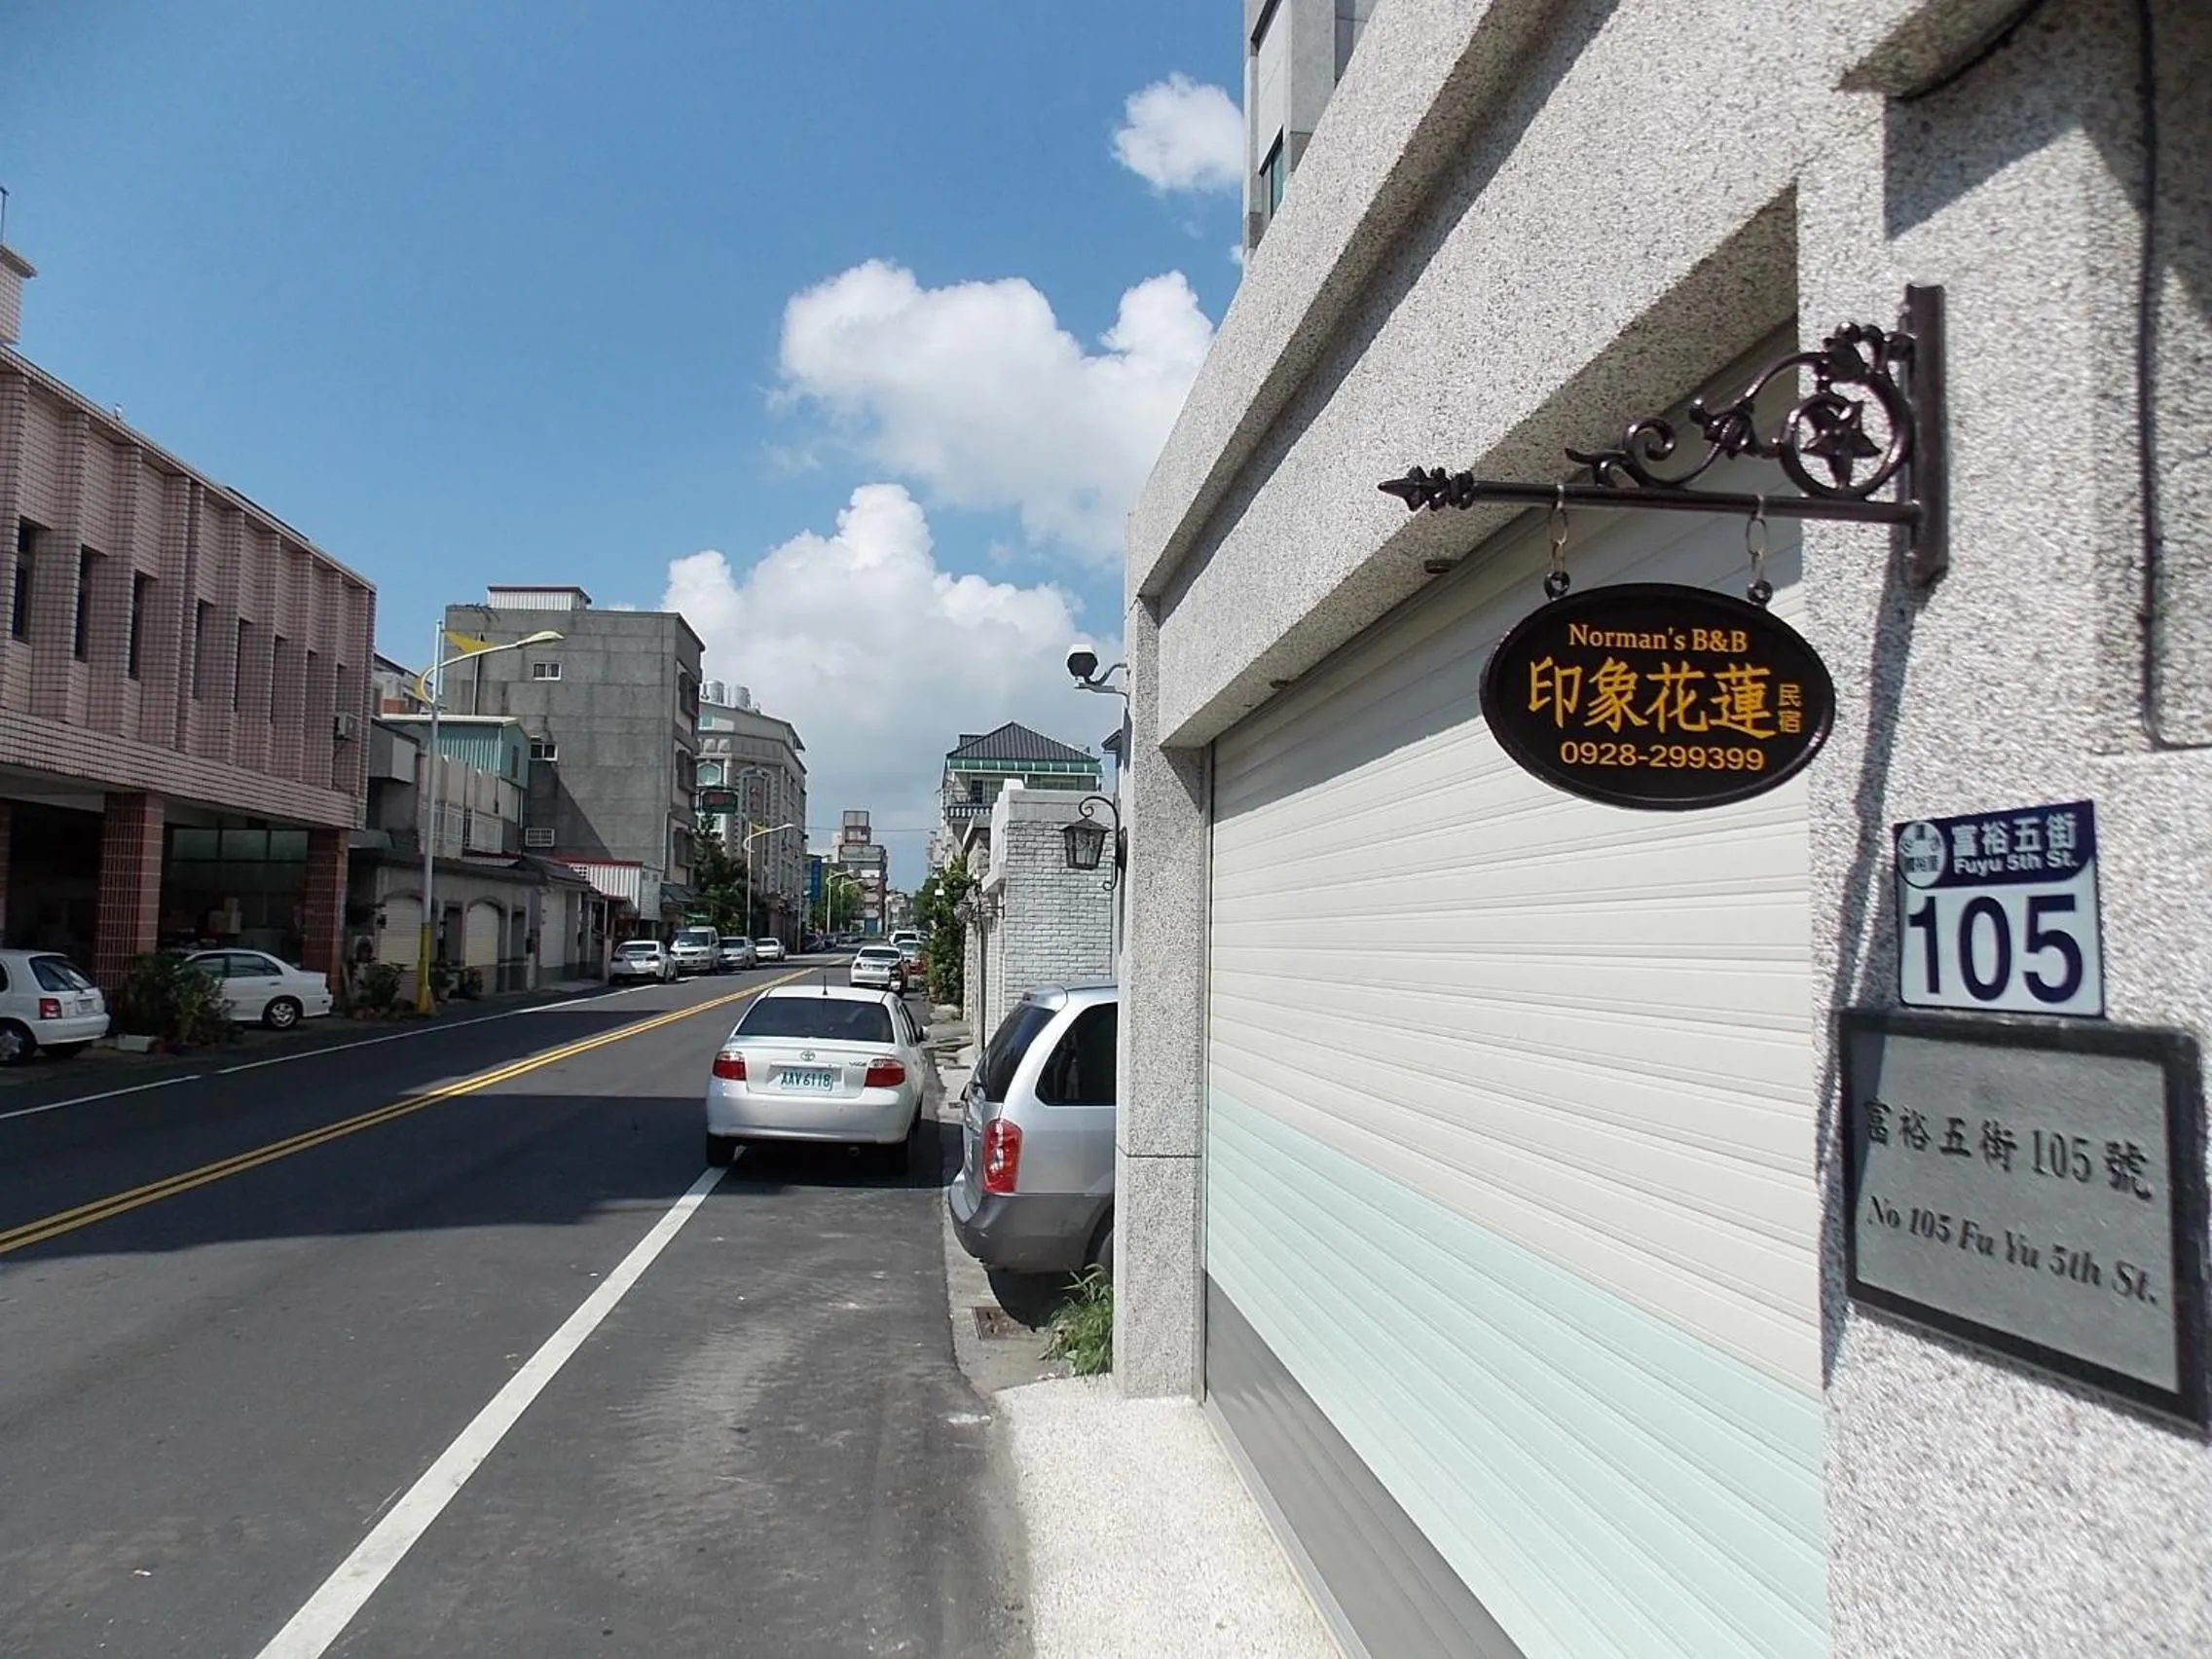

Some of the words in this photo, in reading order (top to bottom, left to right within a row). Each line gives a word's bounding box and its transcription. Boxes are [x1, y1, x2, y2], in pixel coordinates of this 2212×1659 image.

[1568, 624, 1685, 650] Norman's
[1692, 628, 1748, 652] B&B
[1528, 655, 1776, 740] 印象花蓮
[1779, 683, 1802, 733] 民宿
[1561, 741, 1764, 771] 0928-299399
[1951, 813, 2077, 857] 富裕五街
[1953, 858, 2004, 876] Fuyu
[2007, 852, 2043, 871] 5th
[2046, 848, 2081, 868] St.
[1908, 894, 2083, 1004] 105
[1909, 1208, 1951, 1243] 105
[1958, 1219, 1994, 1257] Fu
[2005, 1230, 2040, 1270] Yu
[2048, 1243, 2101, 1286] 5th
[2112, 1260, 2157, 1306] St.
